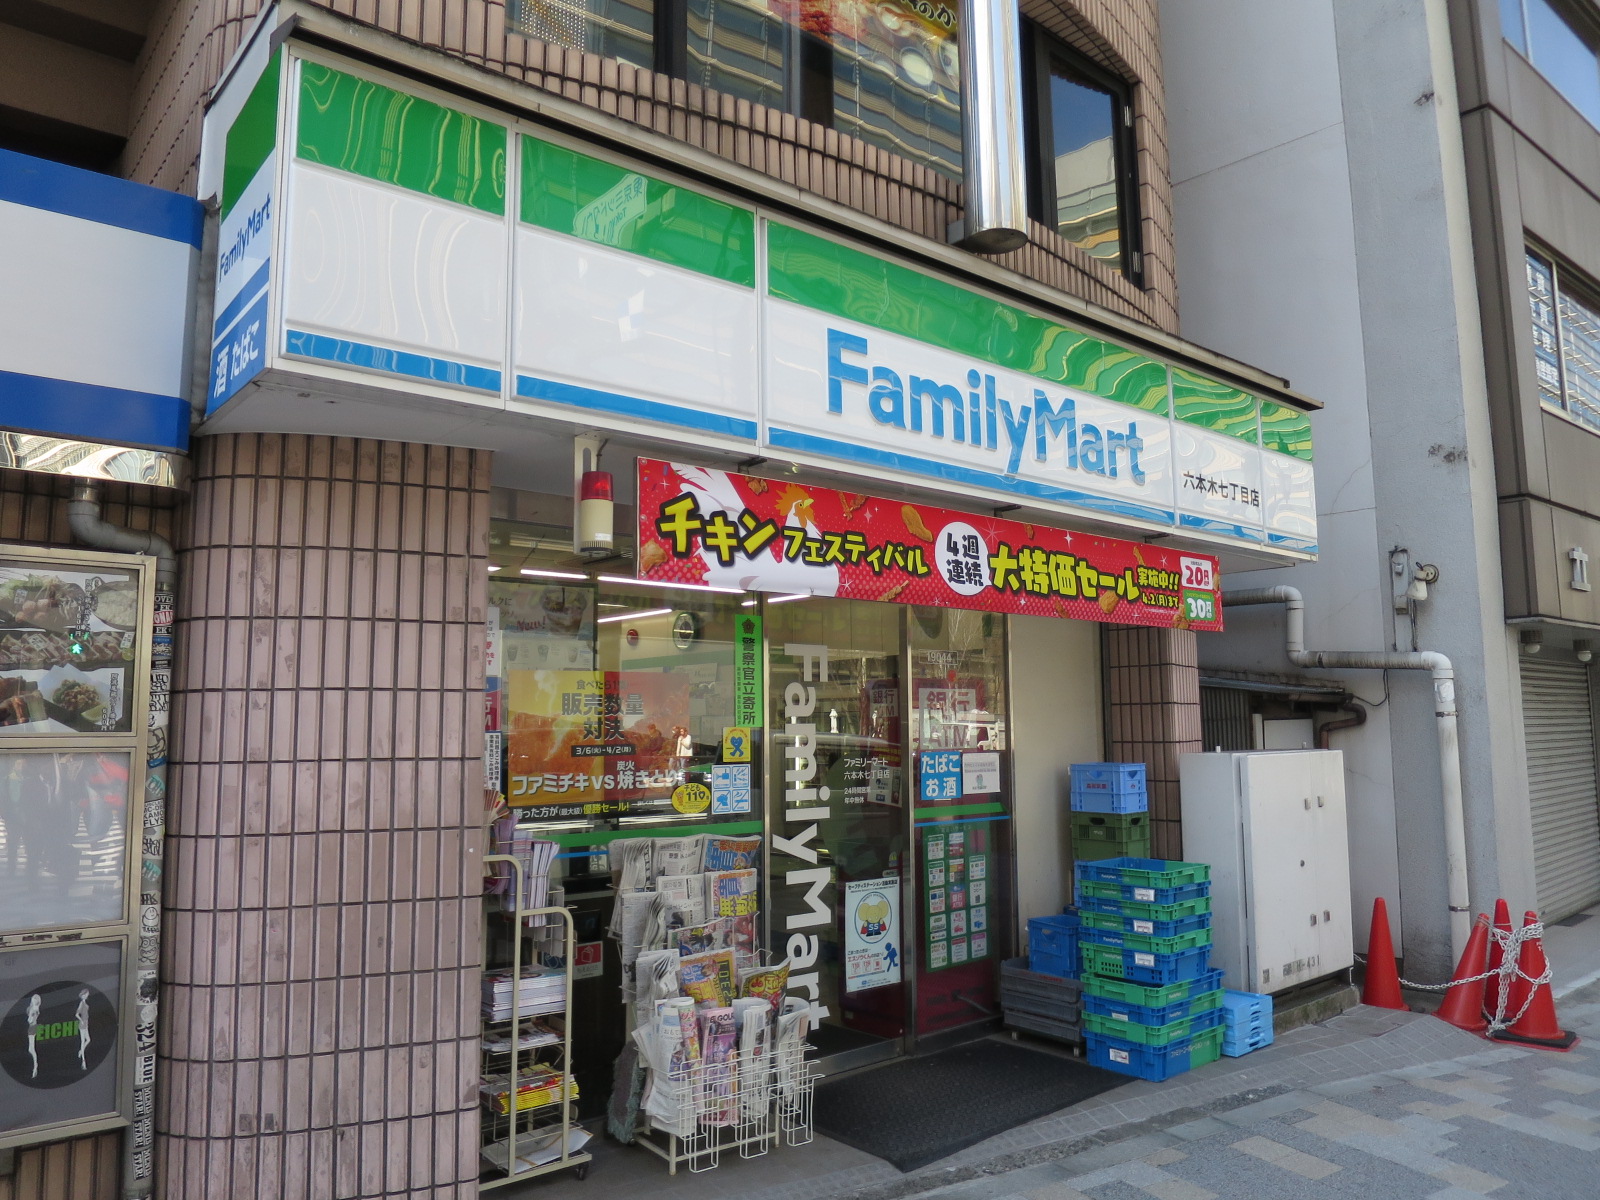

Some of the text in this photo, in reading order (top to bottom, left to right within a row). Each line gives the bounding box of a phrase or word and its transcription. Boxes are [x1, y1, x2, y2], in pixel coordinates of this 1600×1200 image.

[219, 193, 271, 283] FamilyMart
[213, 319, 260, 399] 酒 たばこ
[825, 327, 1147, 487] FamilyMart
[1182, 470, 1261, 508] 六本木七丁目店
[658, 494, 930, 576] チキン フェスティバル
[946, 532, 980, 557] 4週
[946, 558, 985, 588] 連続
[989, 544, 1141, 601] 大特価セール
[742, 637, 756, 725] 警察官立寄所
[561, 692, 644, 717] 販売数量
[583, 717, 625, 741] 対決
[844, 757, 889, 768] ファミリーマート
[844, 770, 890, 780] 六本木七丁目店
[922, 754, 960, 774] たばこ
[512, 773, 590, 795] ファミチキ
[592, 775, 615, 790] VS
[926, 777, 957, 797] お酒
[773, 643, 831, 1030] FamilyMart
[868, 923, 879, 931] SS
[143, 1055, 154, 1083] BLUE
